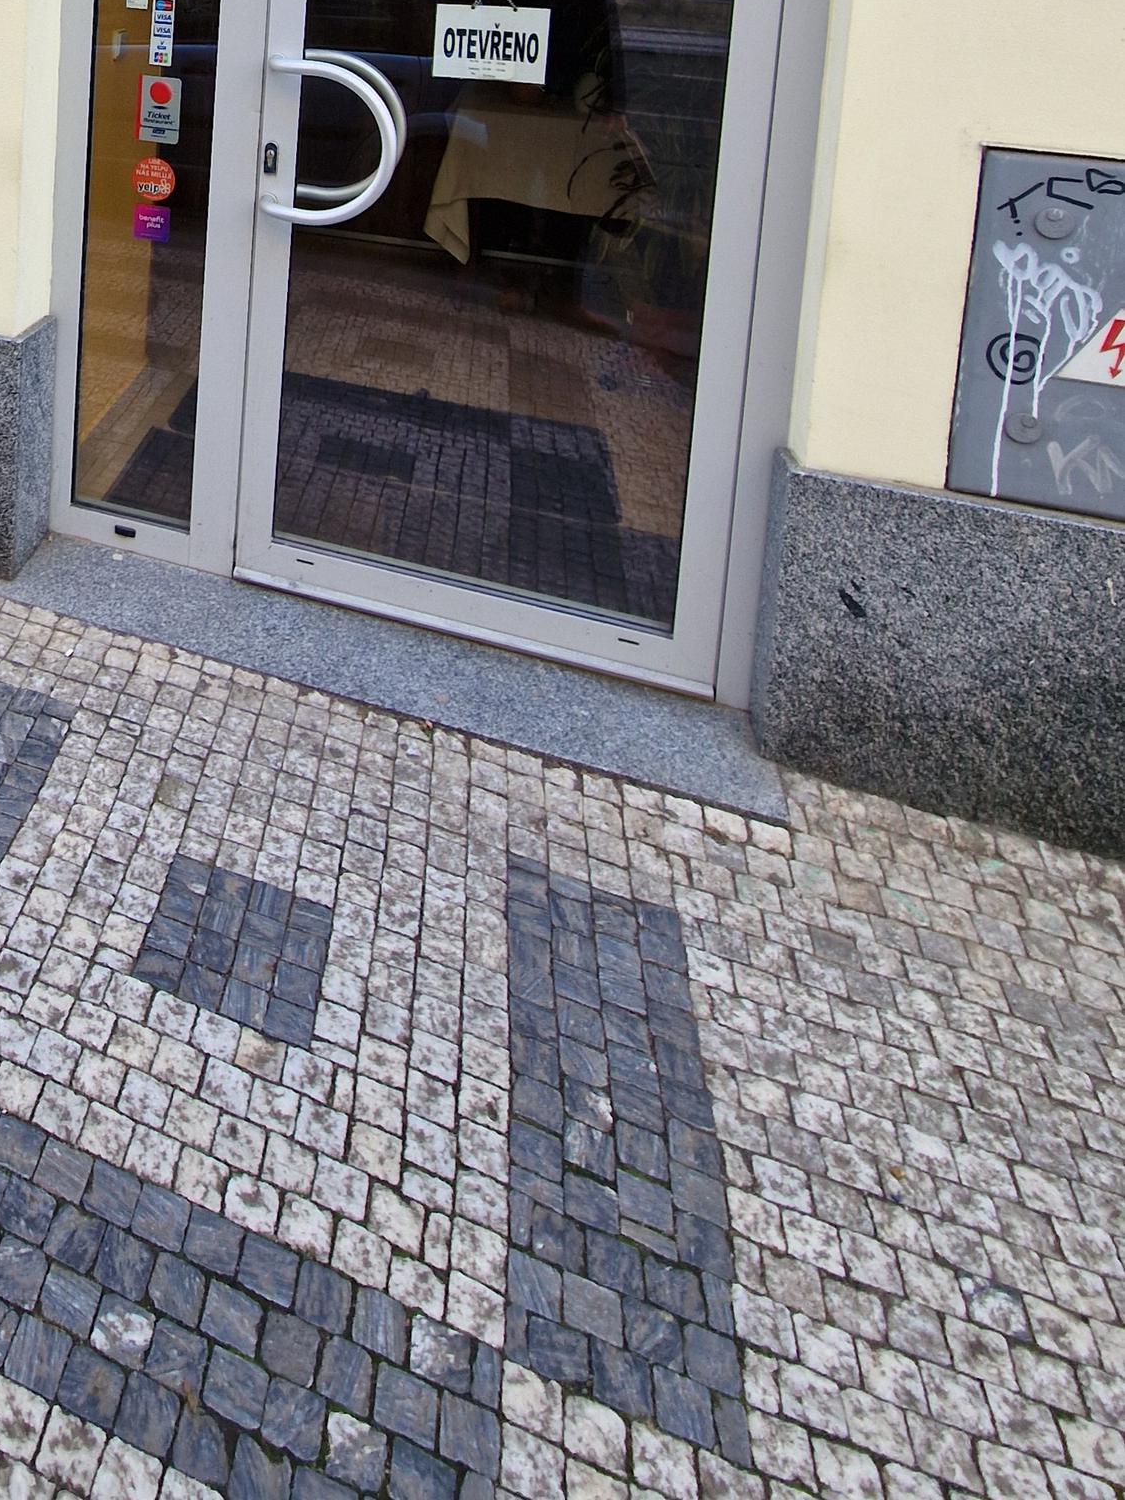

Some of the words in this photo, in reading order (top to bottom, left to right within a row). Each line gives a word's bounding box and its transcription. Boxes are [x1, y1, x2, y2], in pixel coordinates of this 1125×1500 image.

[443, 22, 539, 64] OTEVŘENO
[147, 110, 172, 120] Ticket
[138, 183, 160, 193] yelp
[138, 213, 165, 224] benefit
